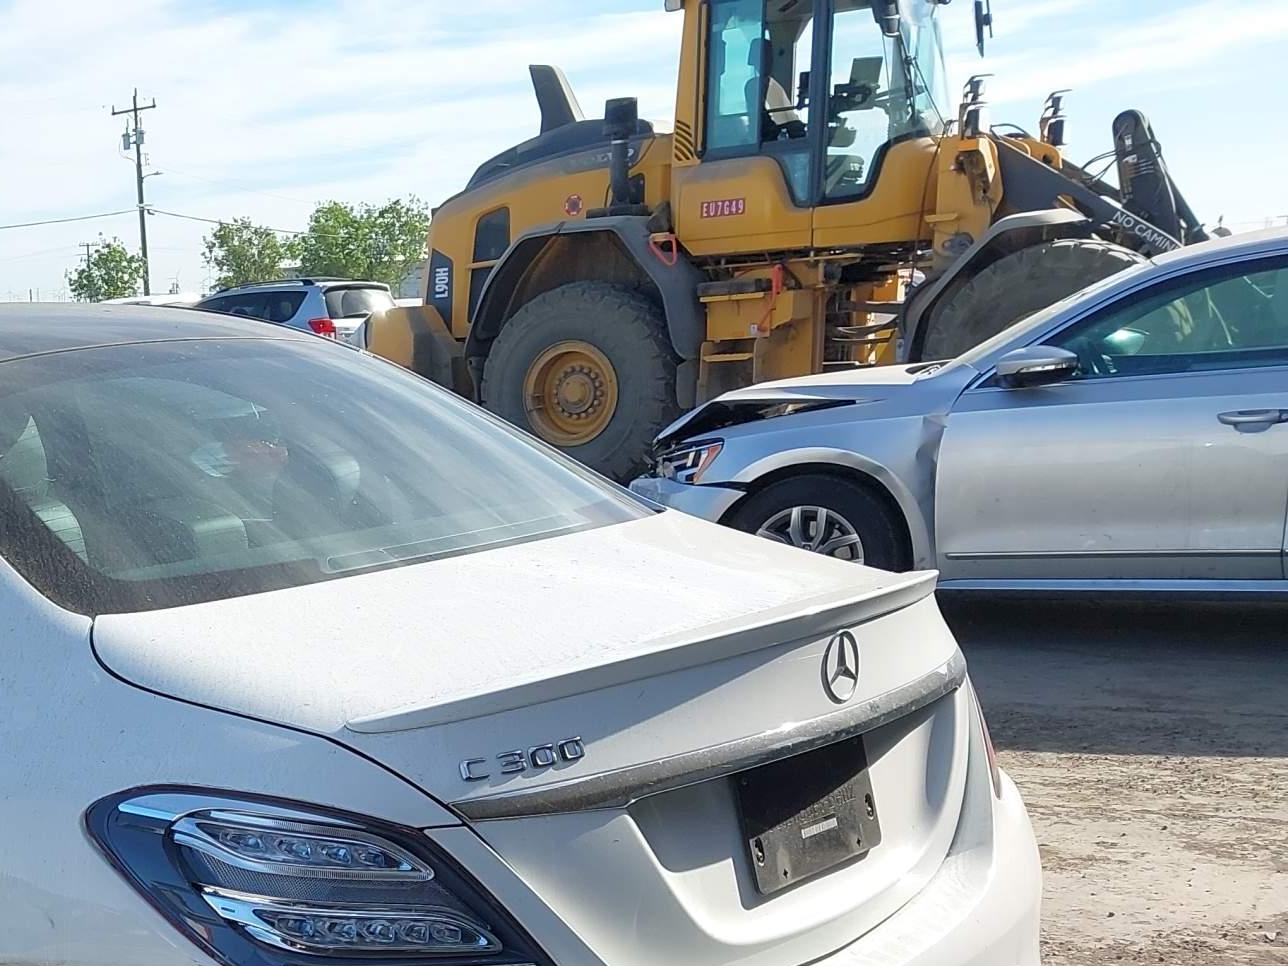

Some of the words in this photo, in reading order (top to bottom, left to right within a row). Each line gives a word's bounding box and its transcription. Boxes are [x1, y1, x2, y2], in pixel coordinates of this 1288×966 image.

[702, 199, 744, 217] EU7G49
[1113, 211, 1135, 228] NO
[1134, 224, 1179, 251] CAMIN
[434, 267, 449, 299] L90H
[458, 758, 490, 782] C
[496, 736, 586, 775] 300
